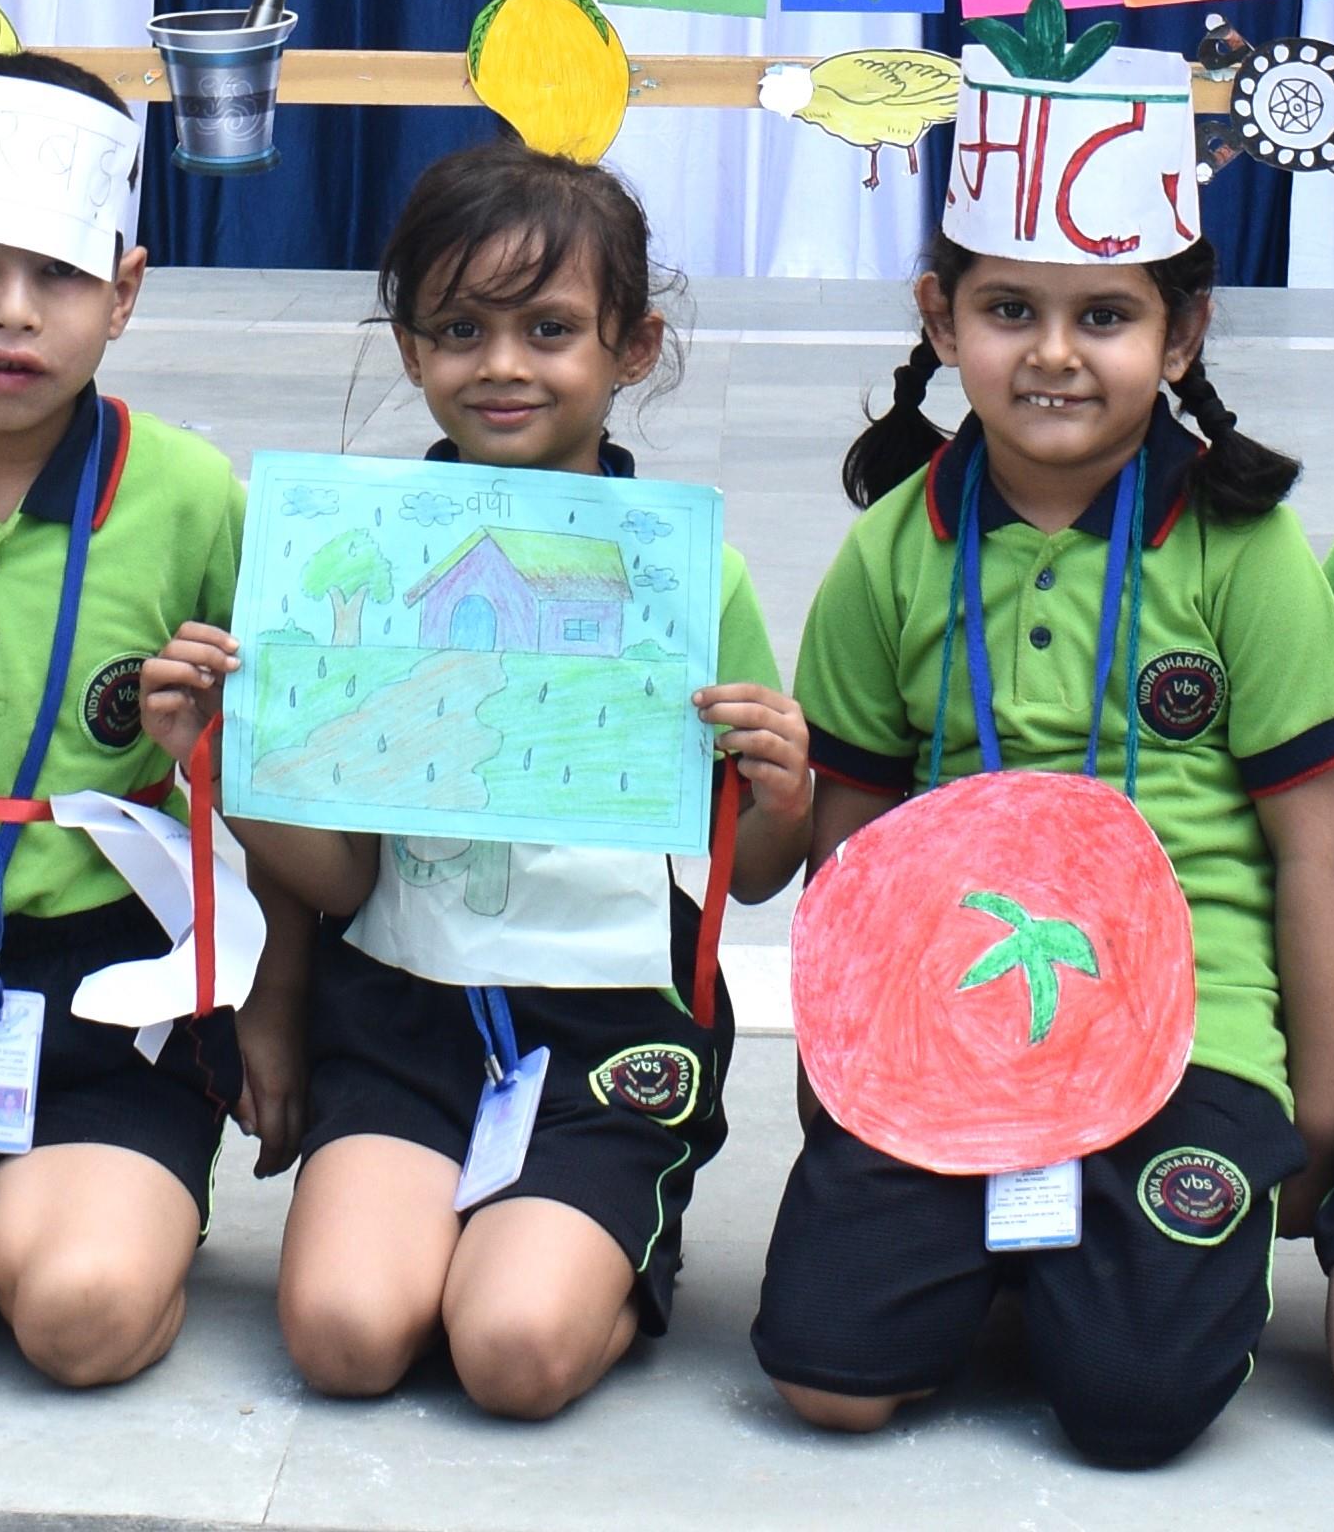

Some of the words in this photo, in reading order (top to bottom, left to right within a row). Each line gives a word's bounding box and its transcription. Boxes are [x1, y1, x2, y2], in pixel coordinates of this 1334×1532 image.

[462, 478, 514, 519] वर्षा
[101, 661, 141, 686] BHARA
[1173, 679, 1201, 697] vbs
[1179, 1173, 1213, 1190] vbs
